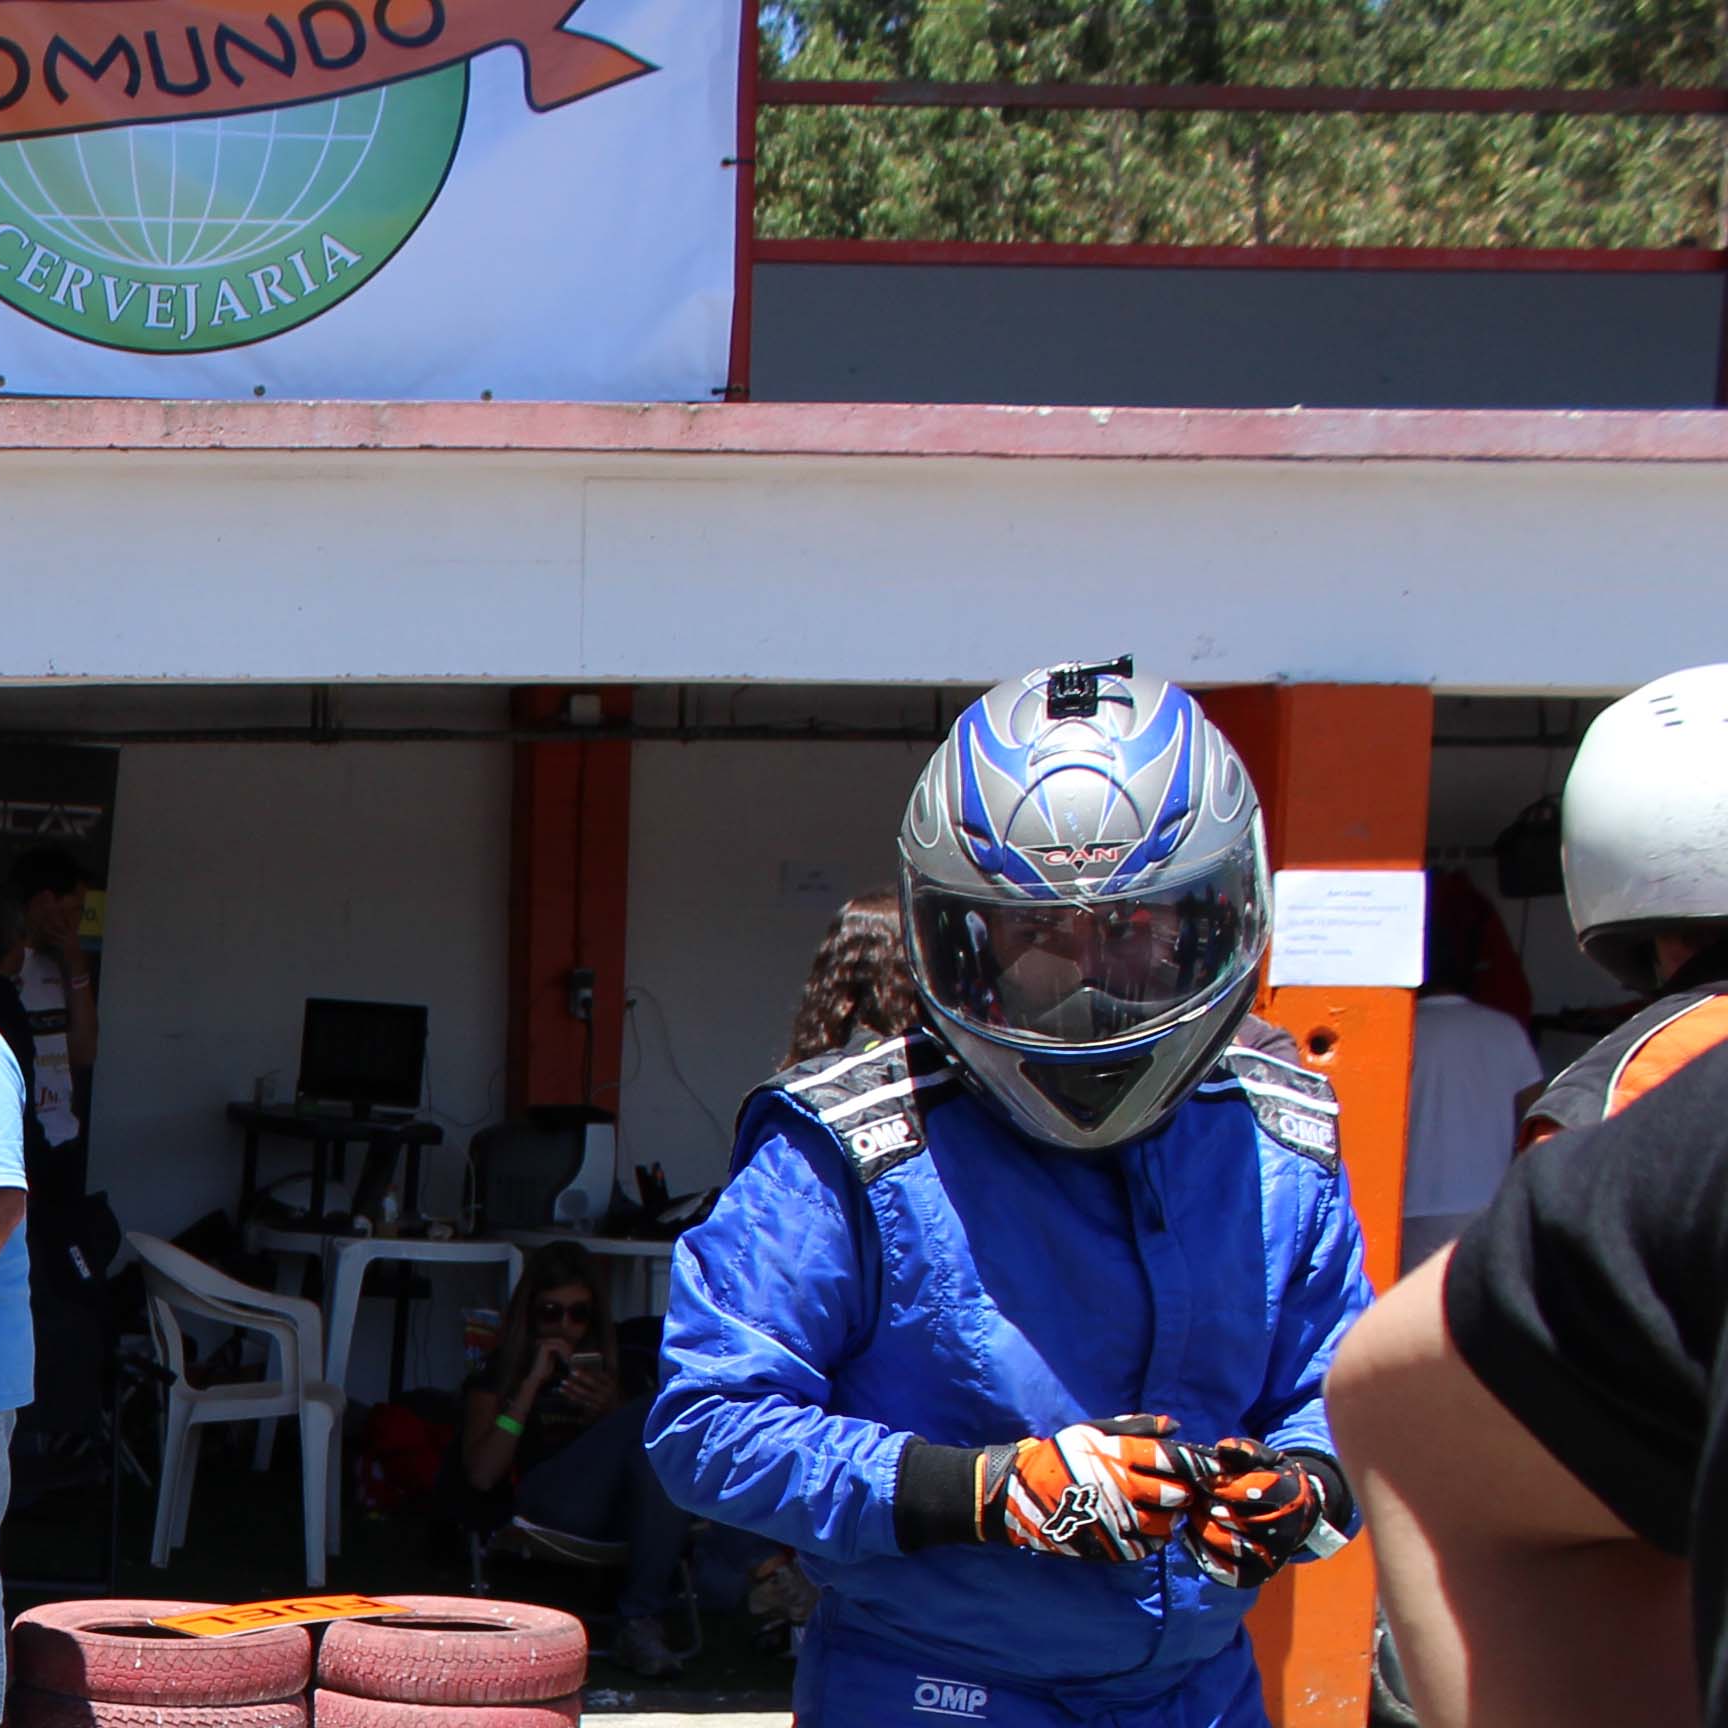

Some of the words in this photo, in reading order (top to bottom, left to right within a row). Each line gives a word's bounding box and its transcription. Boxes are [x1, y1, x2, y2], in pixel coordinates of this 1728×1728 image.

[1044, 847, 1119, 866] CAN
[851, 1119, 912, 1157] OMP
[1280, 1114, 1332, 1144] OMP
[176, 1598, 387, 1626] FUEL
[914, 1682, 988, 1713] OMP
